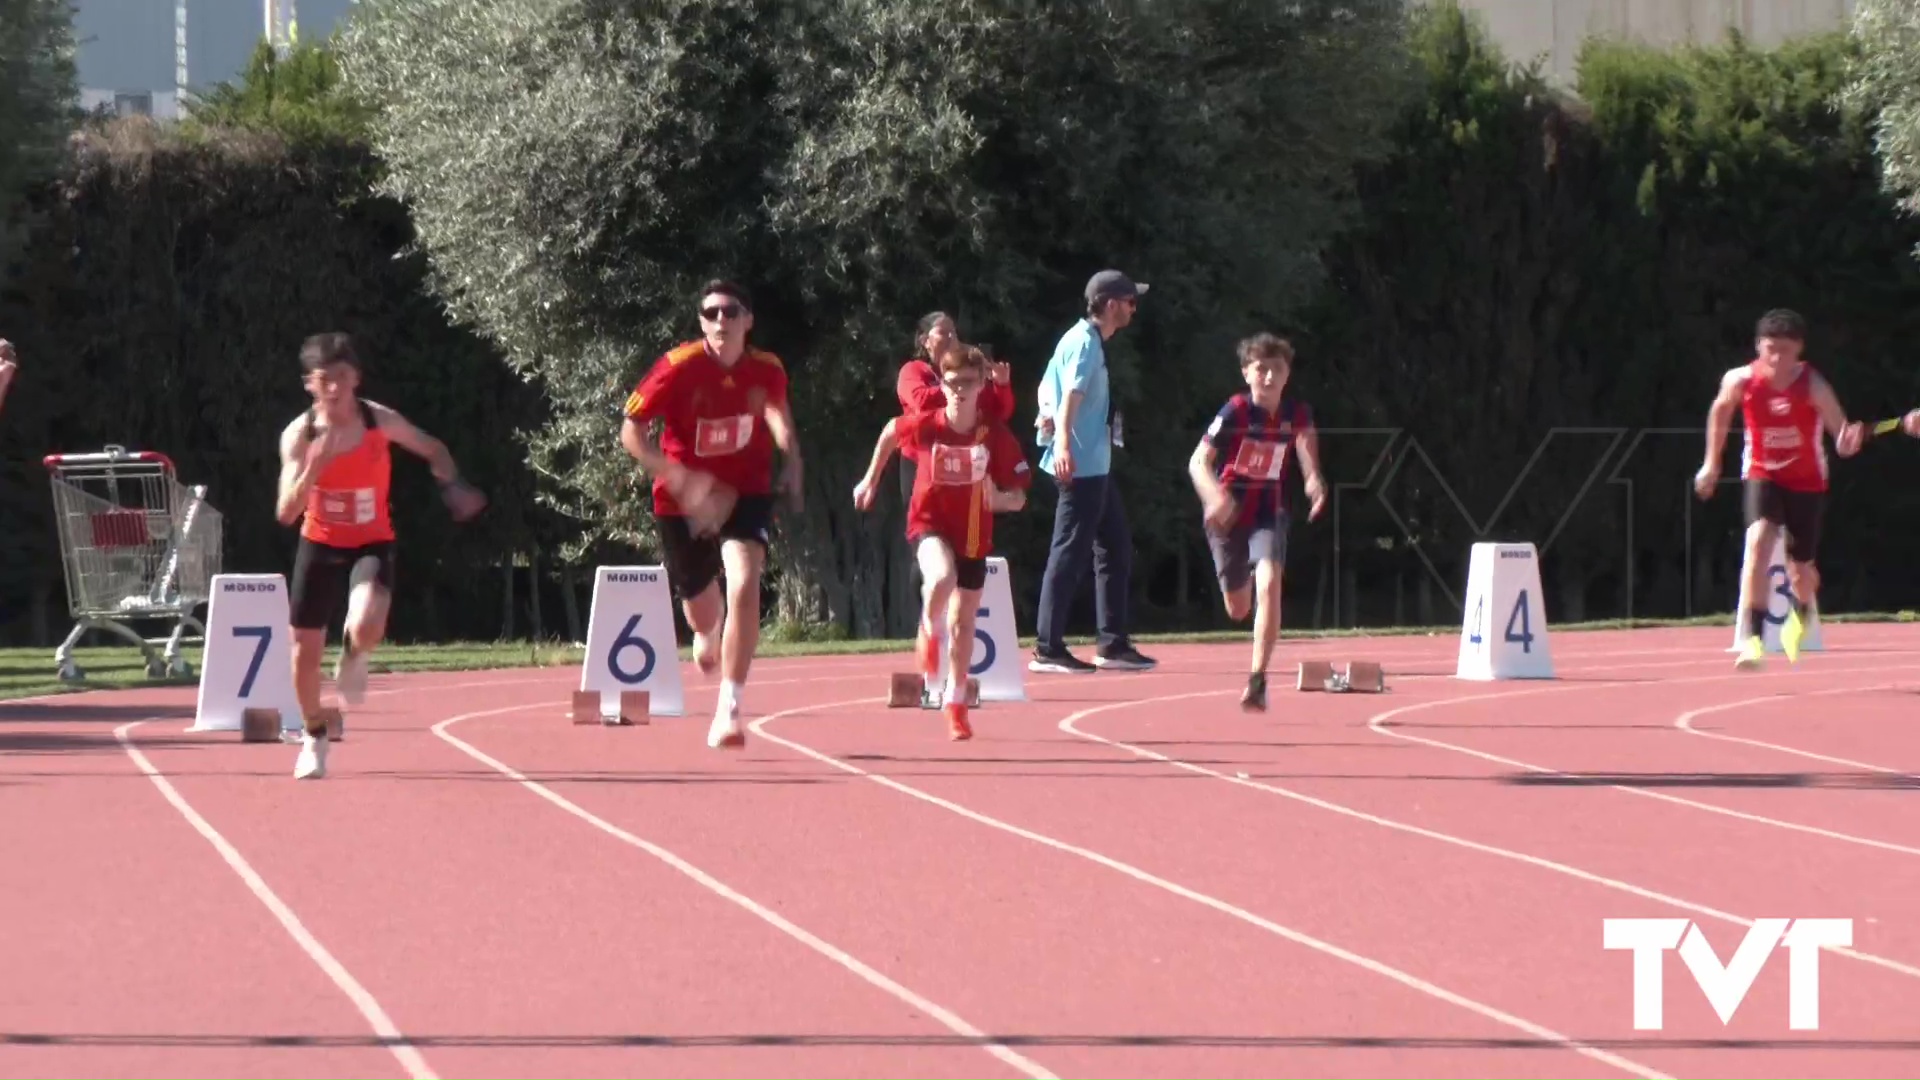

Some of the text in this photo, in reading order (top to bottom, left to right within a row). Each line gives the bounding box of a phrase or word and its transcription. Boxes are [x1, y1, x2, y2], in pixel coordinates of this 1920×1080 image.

[223, 582, 277, 593] MONDO
[606, 573, 658, 583] MONDO
[1765, 564, 1798, 625] 3
[607, 613, 656, 685] 6
[1504, 588, 1534, 654] 4
[232, 626, 272, 698] 7
